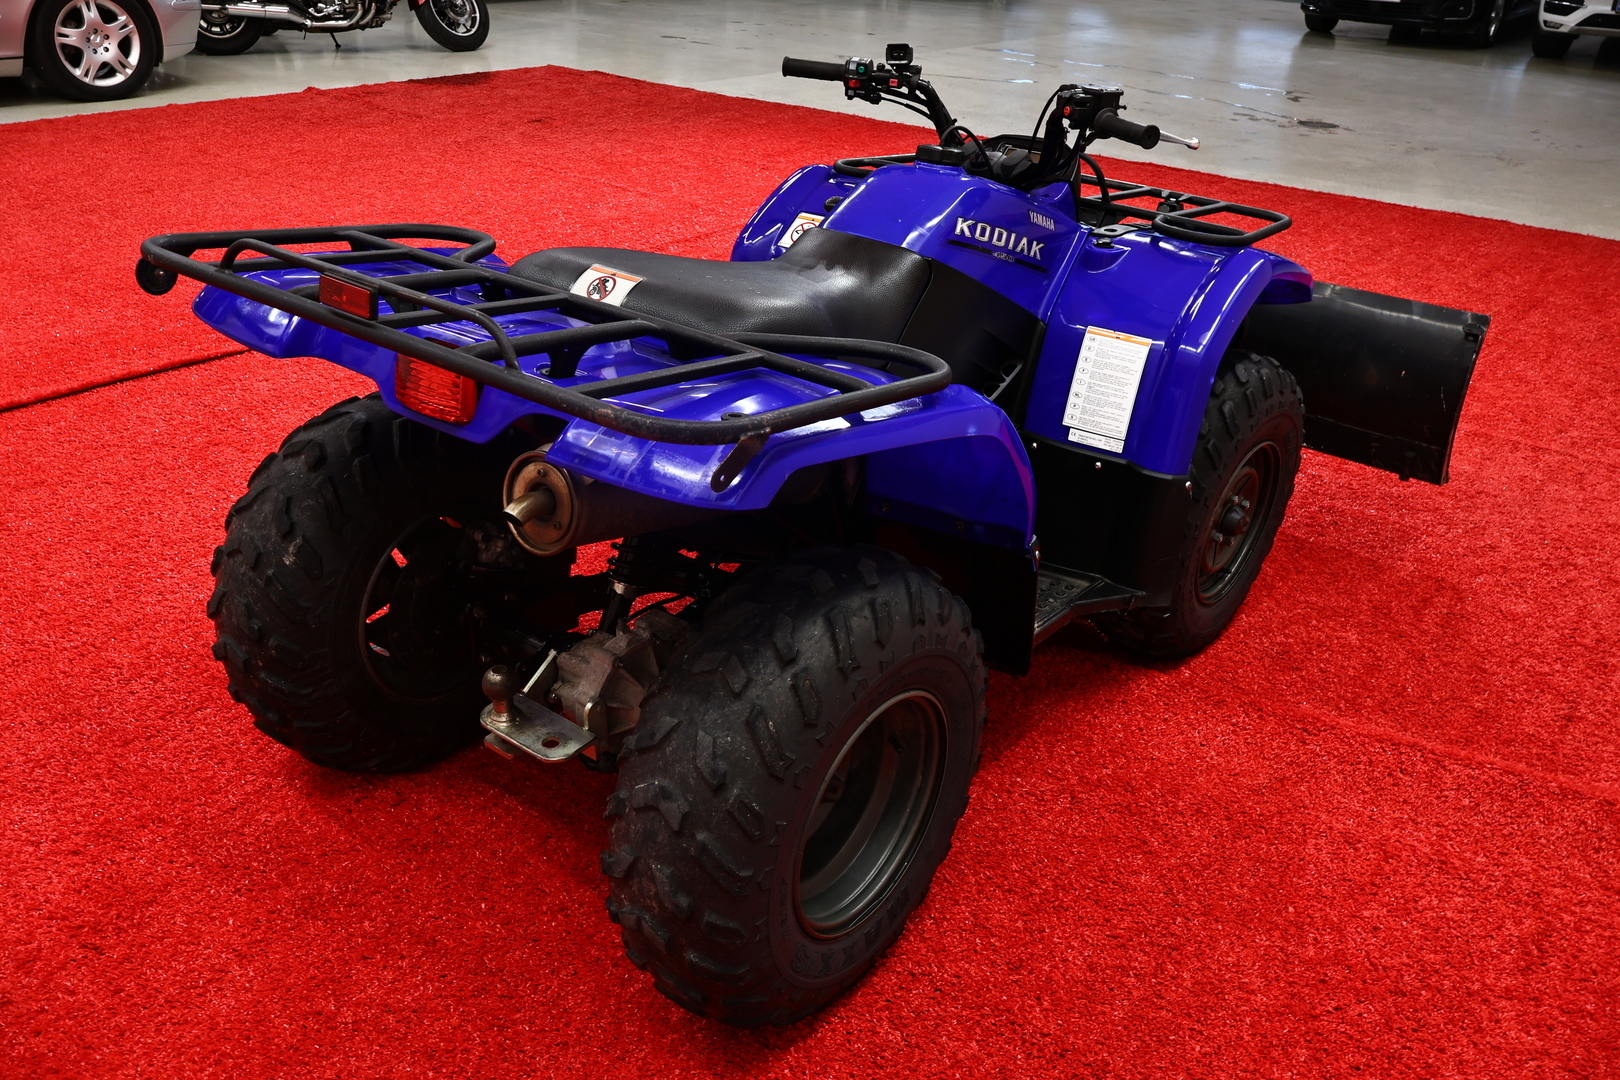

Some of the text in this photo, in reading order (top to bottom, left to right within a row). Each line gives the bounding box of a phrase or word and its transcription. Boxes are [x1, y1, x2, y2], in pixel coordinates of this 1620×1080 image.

[954, 217, 1046, 261] KODIAK
[1028, 210, 1055, 231] YAMAHA
[791, 885, 911, 978] MAXXIS
